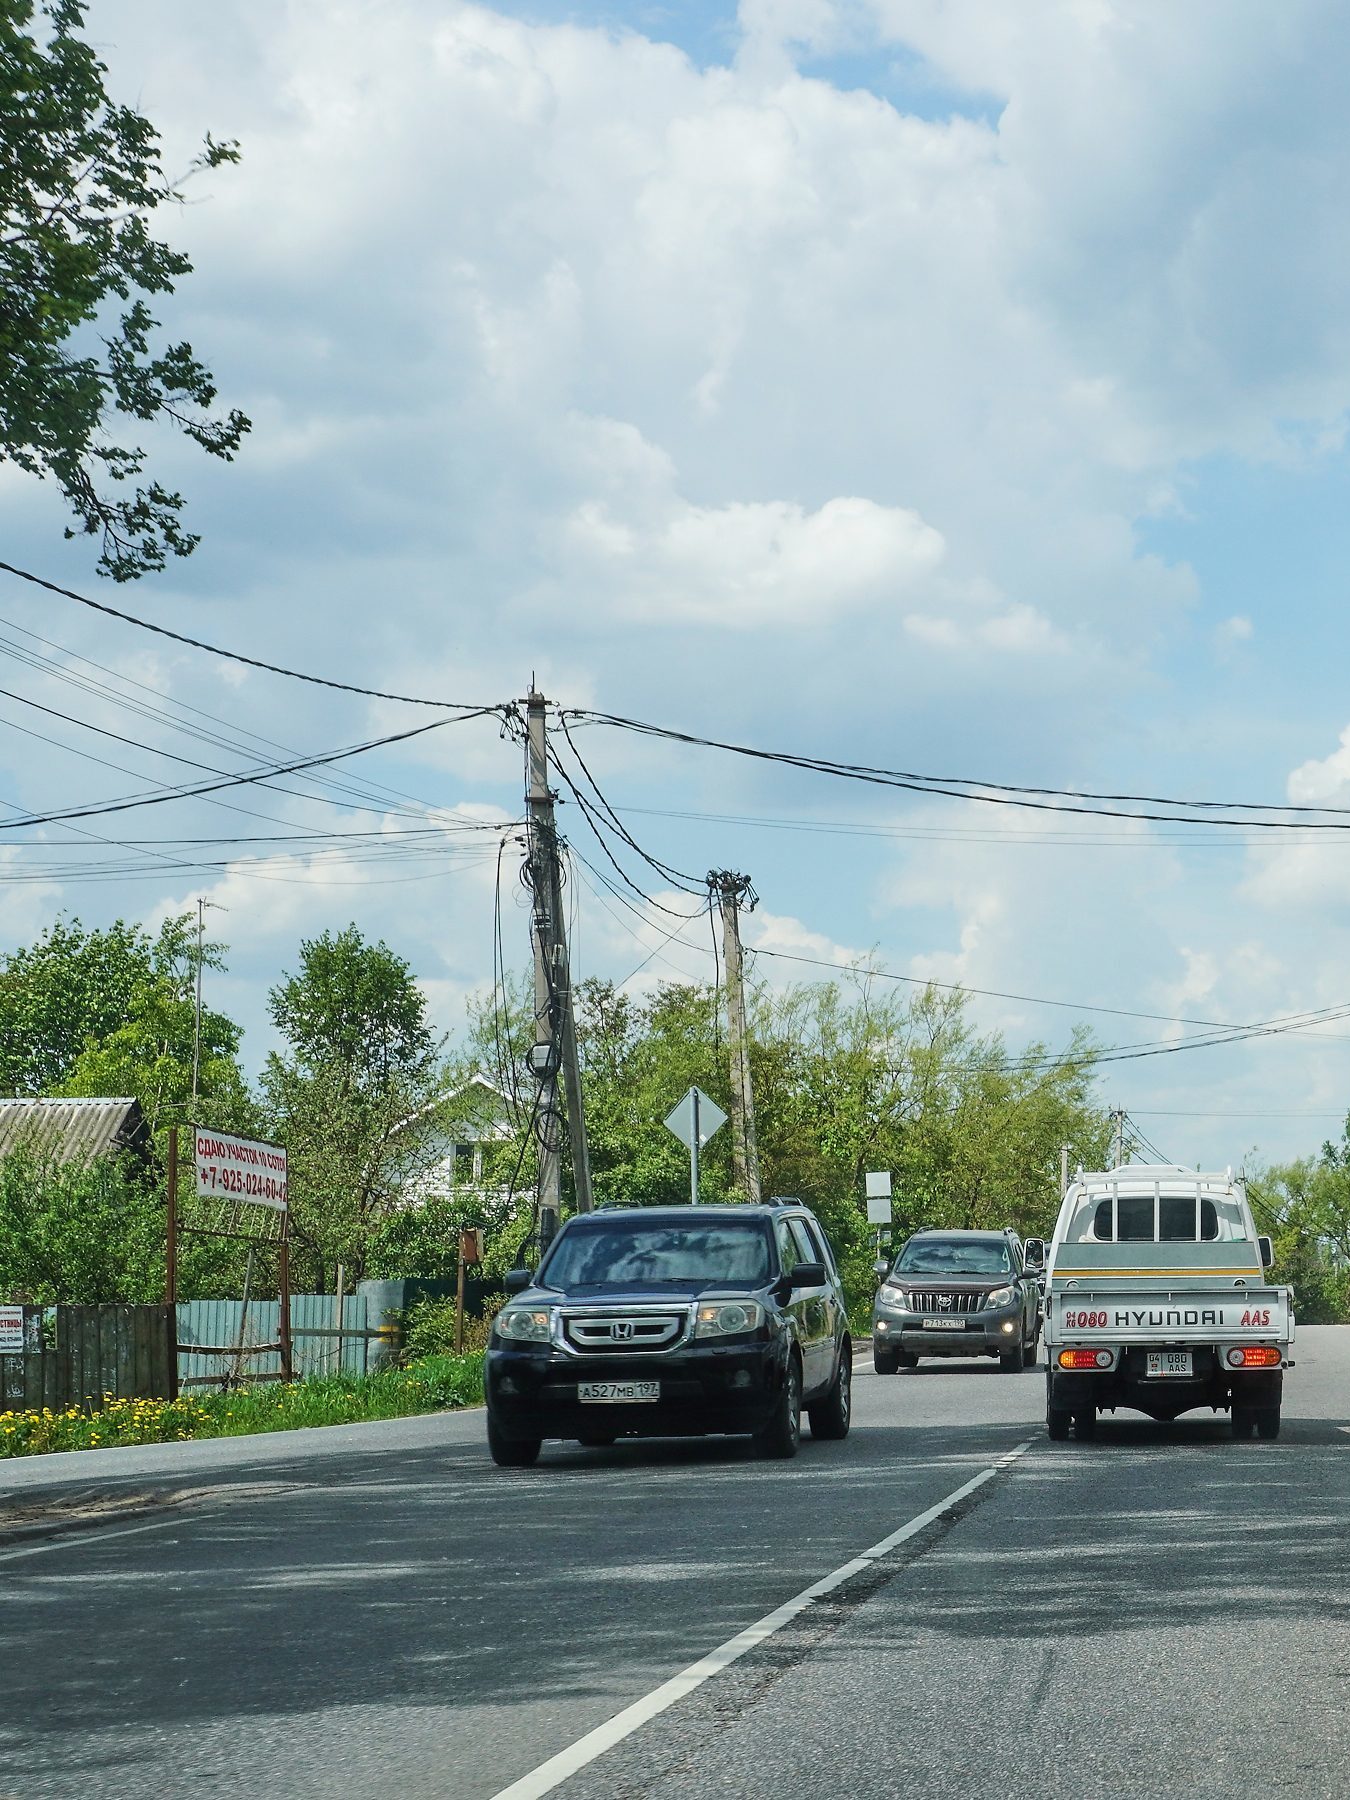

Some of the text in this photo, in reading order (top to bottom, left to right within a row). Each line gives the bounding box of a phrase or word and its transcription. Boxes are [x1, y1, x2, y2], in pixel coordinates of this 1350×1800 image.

[197, 1137, 286, 1173] СДАЮ УЧАСТОК 10 СОТОК
[1077, 1311, 1108, 1328] 080
[1115, 1310, 1224, 1327] HYUNDAI
[1240, 1310, 1271, 1326] AAS
[1167, 1353, 1187, 1363] 080
[1169, 1363, 1187, 1373] AAS
[583, 1383, 656, 1398] А527МВ 197
